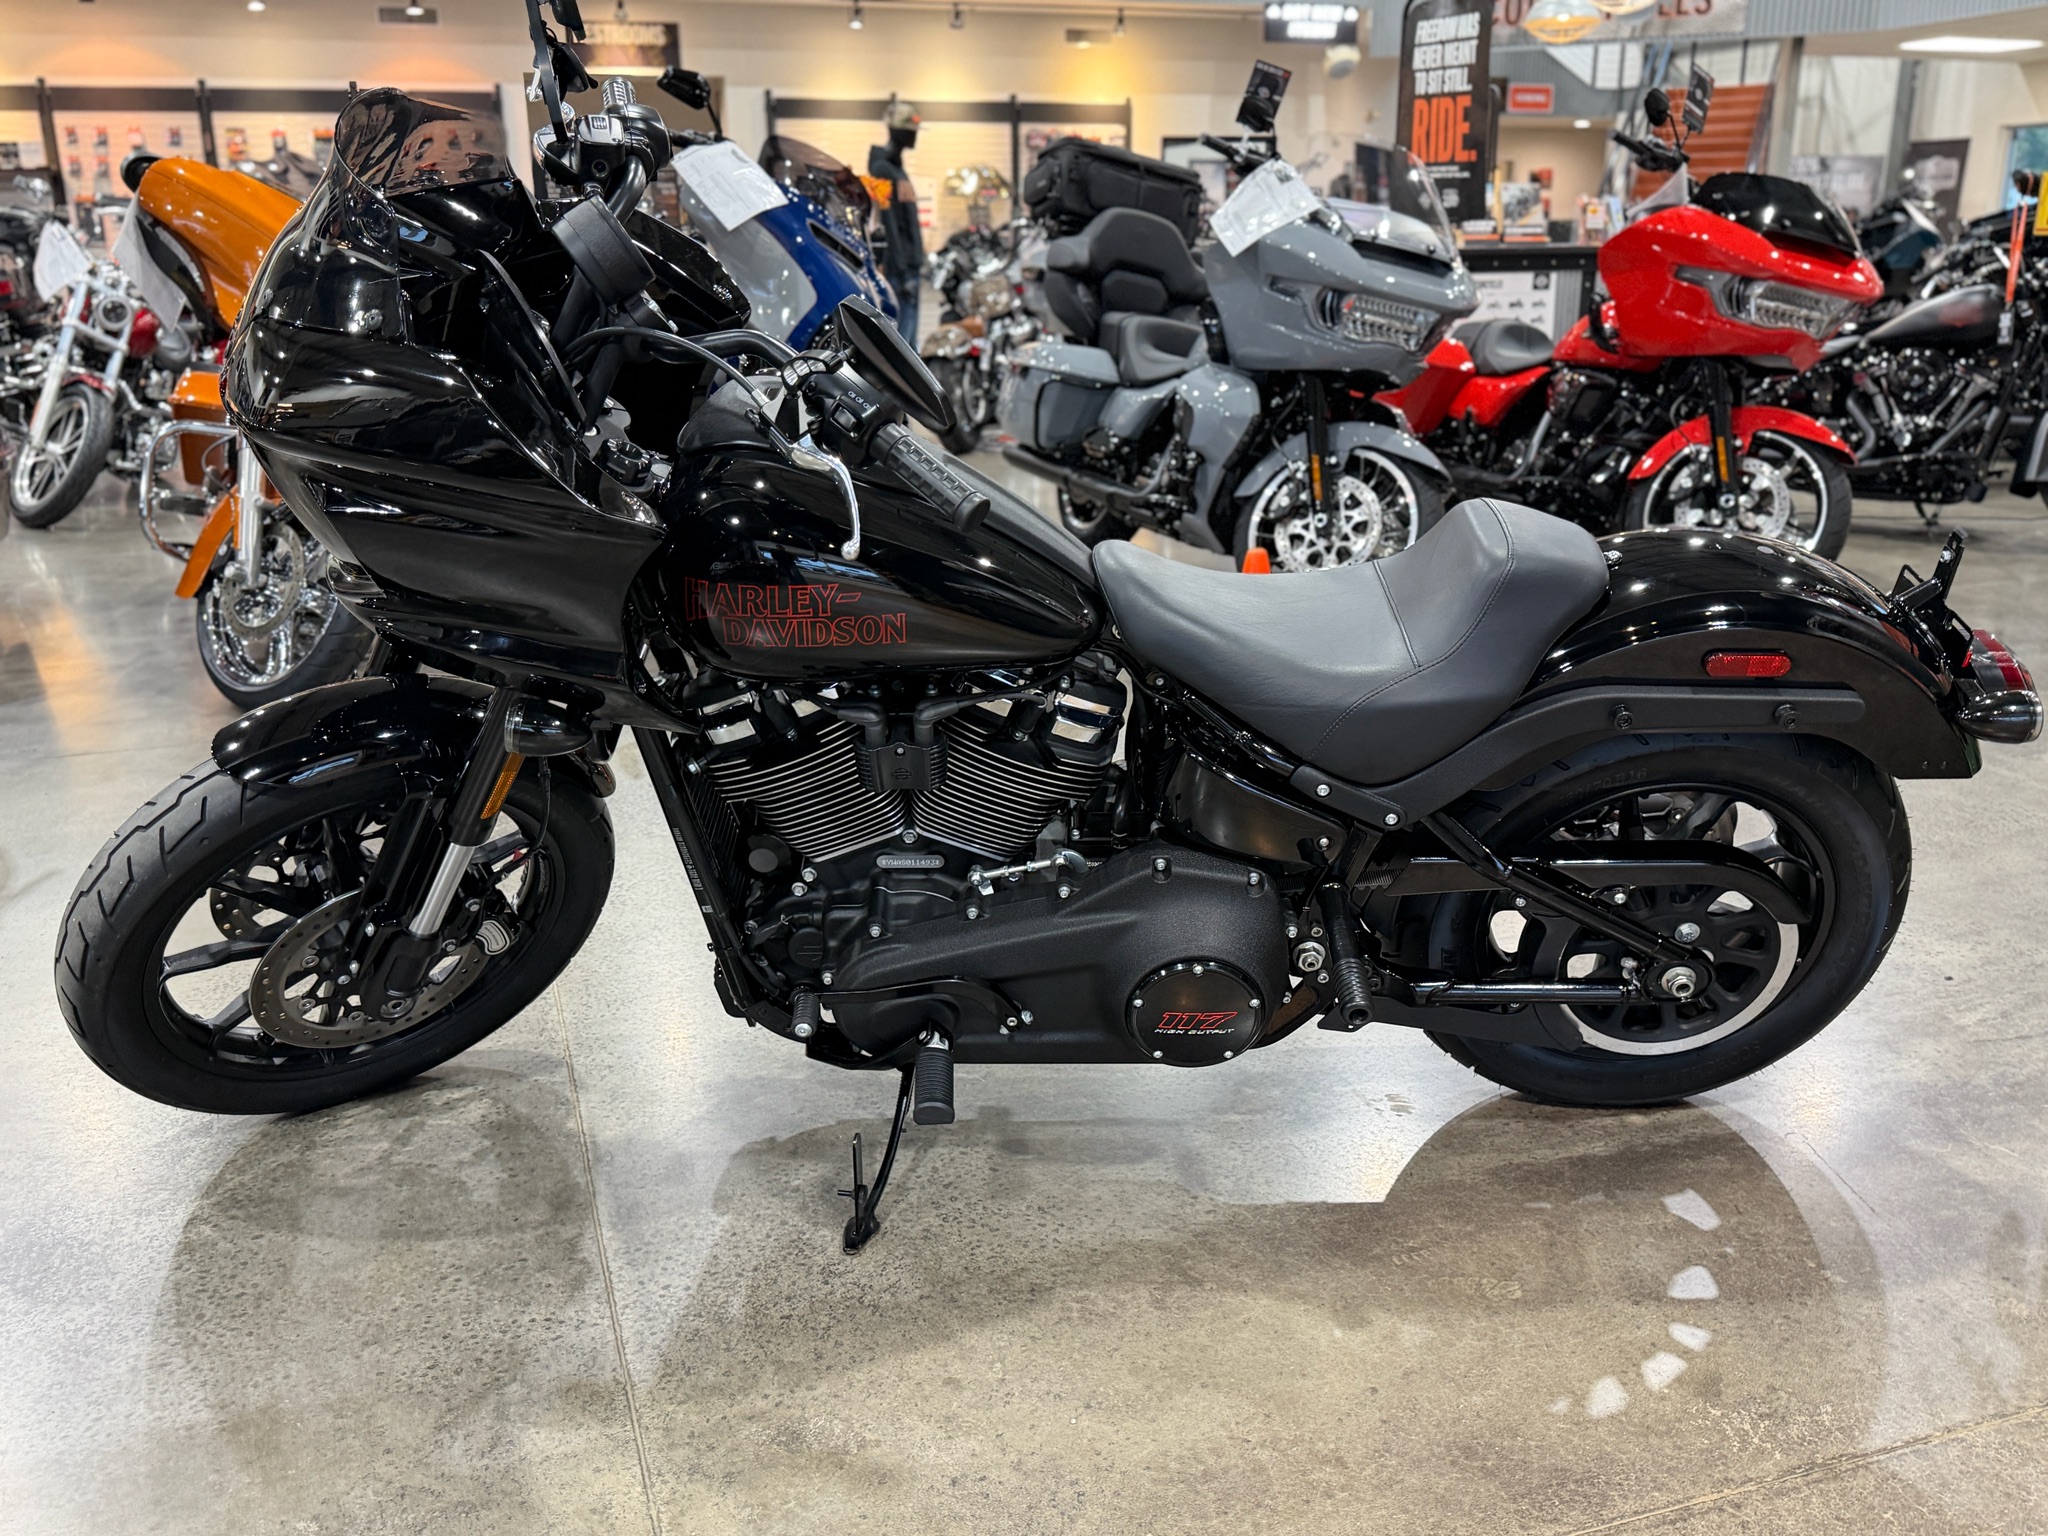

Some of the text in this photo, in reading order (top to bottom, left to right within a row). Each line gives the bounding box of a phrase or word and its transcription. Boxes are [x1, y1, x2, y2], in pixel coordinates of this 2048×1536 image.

[583, 23, 667, 45] ESTROOMS
[1414, 17, 1457, 45] FREEDOM
[1457, 11, 1480, 39] WAS
[1412, 39, 1478, 70] NEVER MEANT
[1414, 66, 1472, 95] TO SIT STILL.
[1408, 94, 1477, 164] RIDE.
[685, 576, 861, 621] HARLEY-
[722, 612, 906, 648] DAVIDSON
[1158, 1011, 1238, 1029] 117
[1187, 1028, 1235, 1036] OUTPUT
